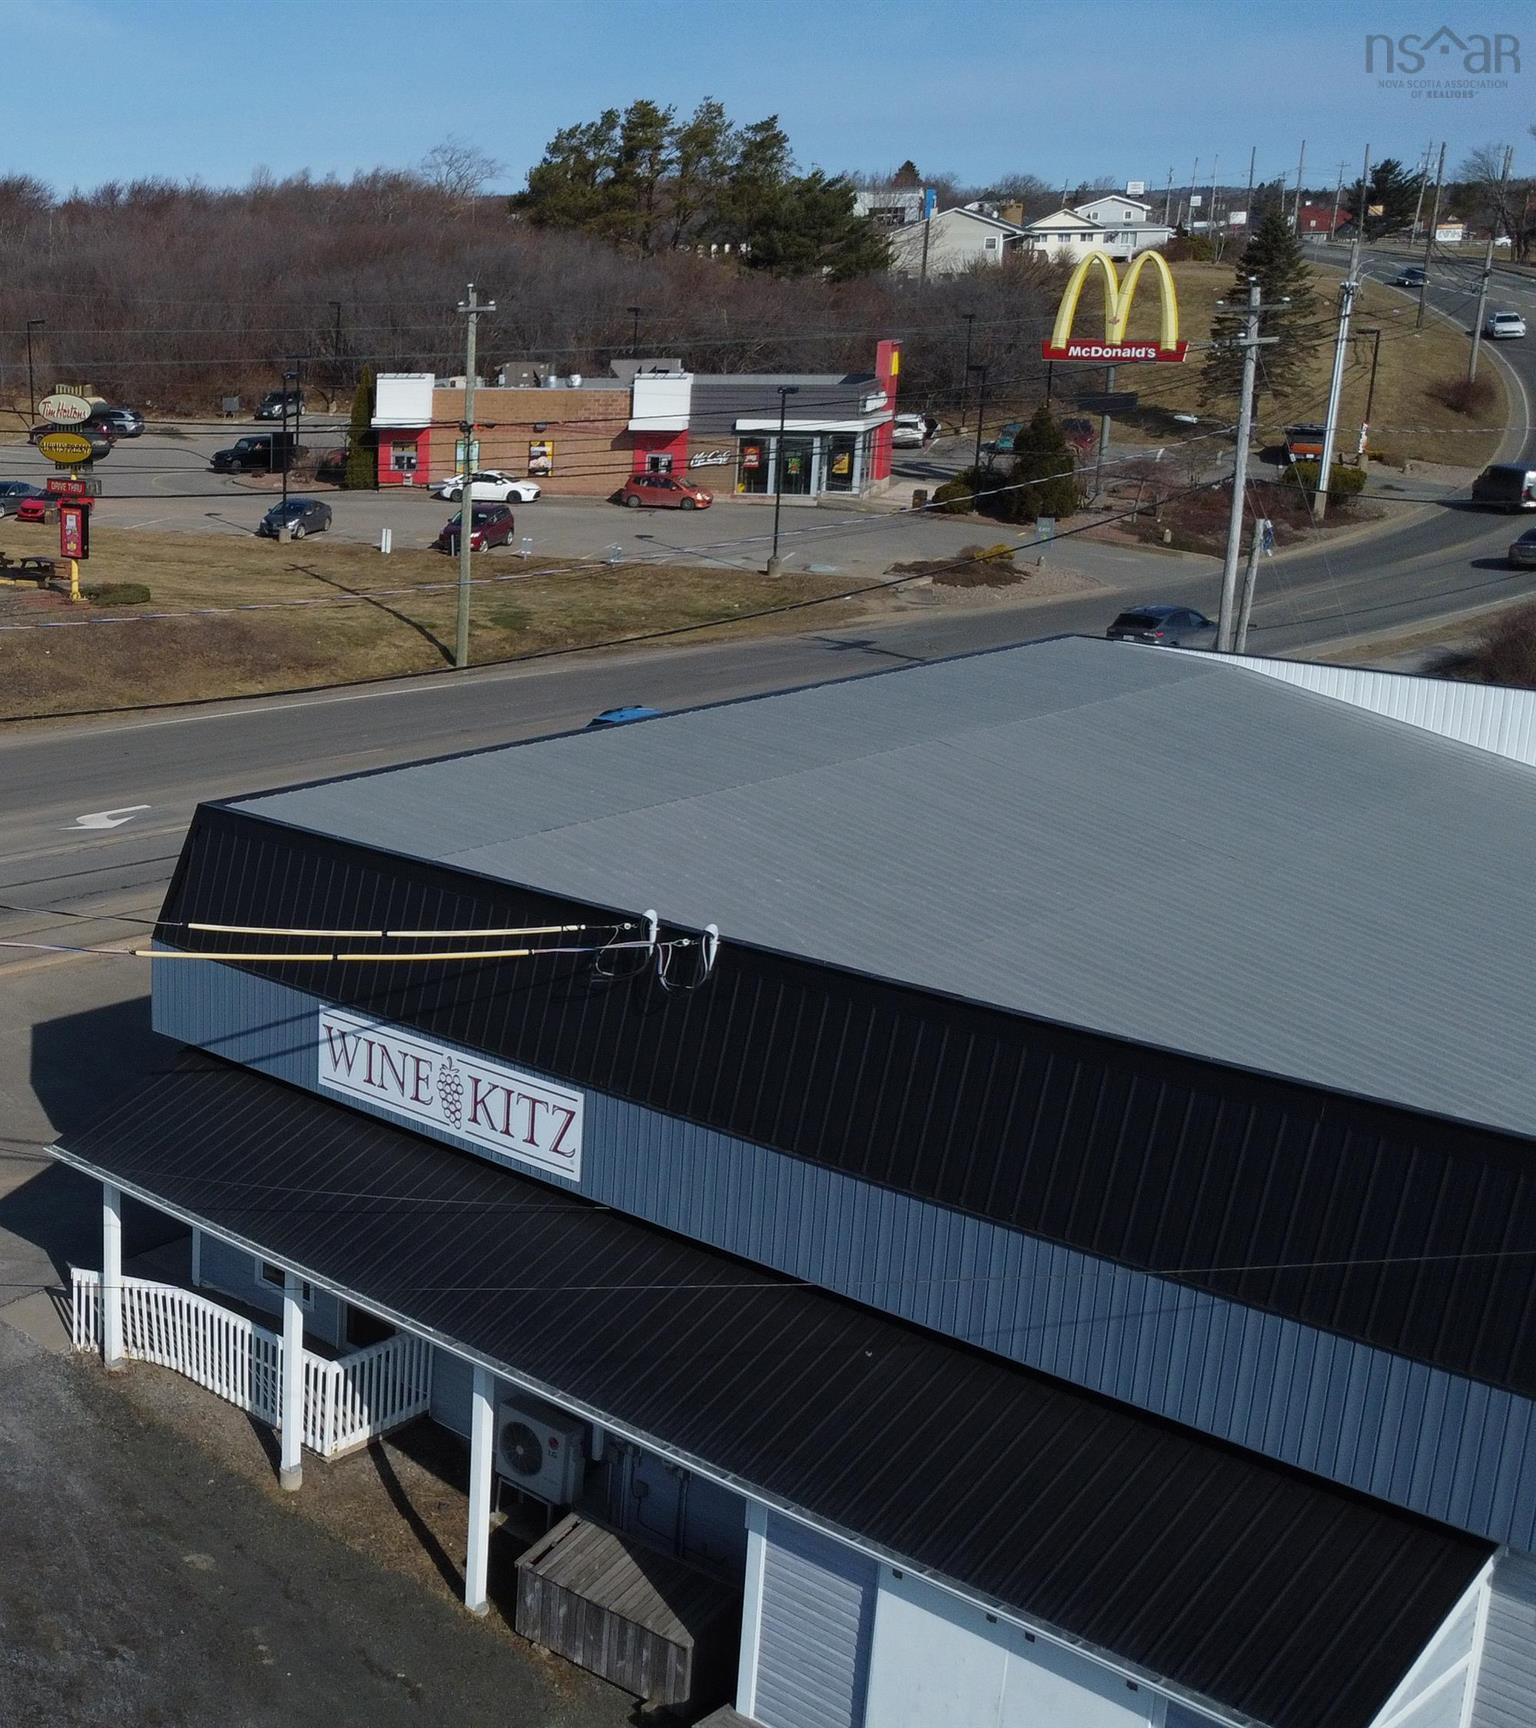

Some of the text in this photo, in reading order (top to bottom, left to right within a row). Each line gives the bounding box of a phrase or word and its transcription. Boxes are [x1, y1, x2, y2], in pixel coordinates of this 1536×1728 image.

[1067, 345, 1157, 359] McDonald's
[42, 401, 87, 420] Tim Hortons
[322, 1023, 577, 1158] WINE KITZ
